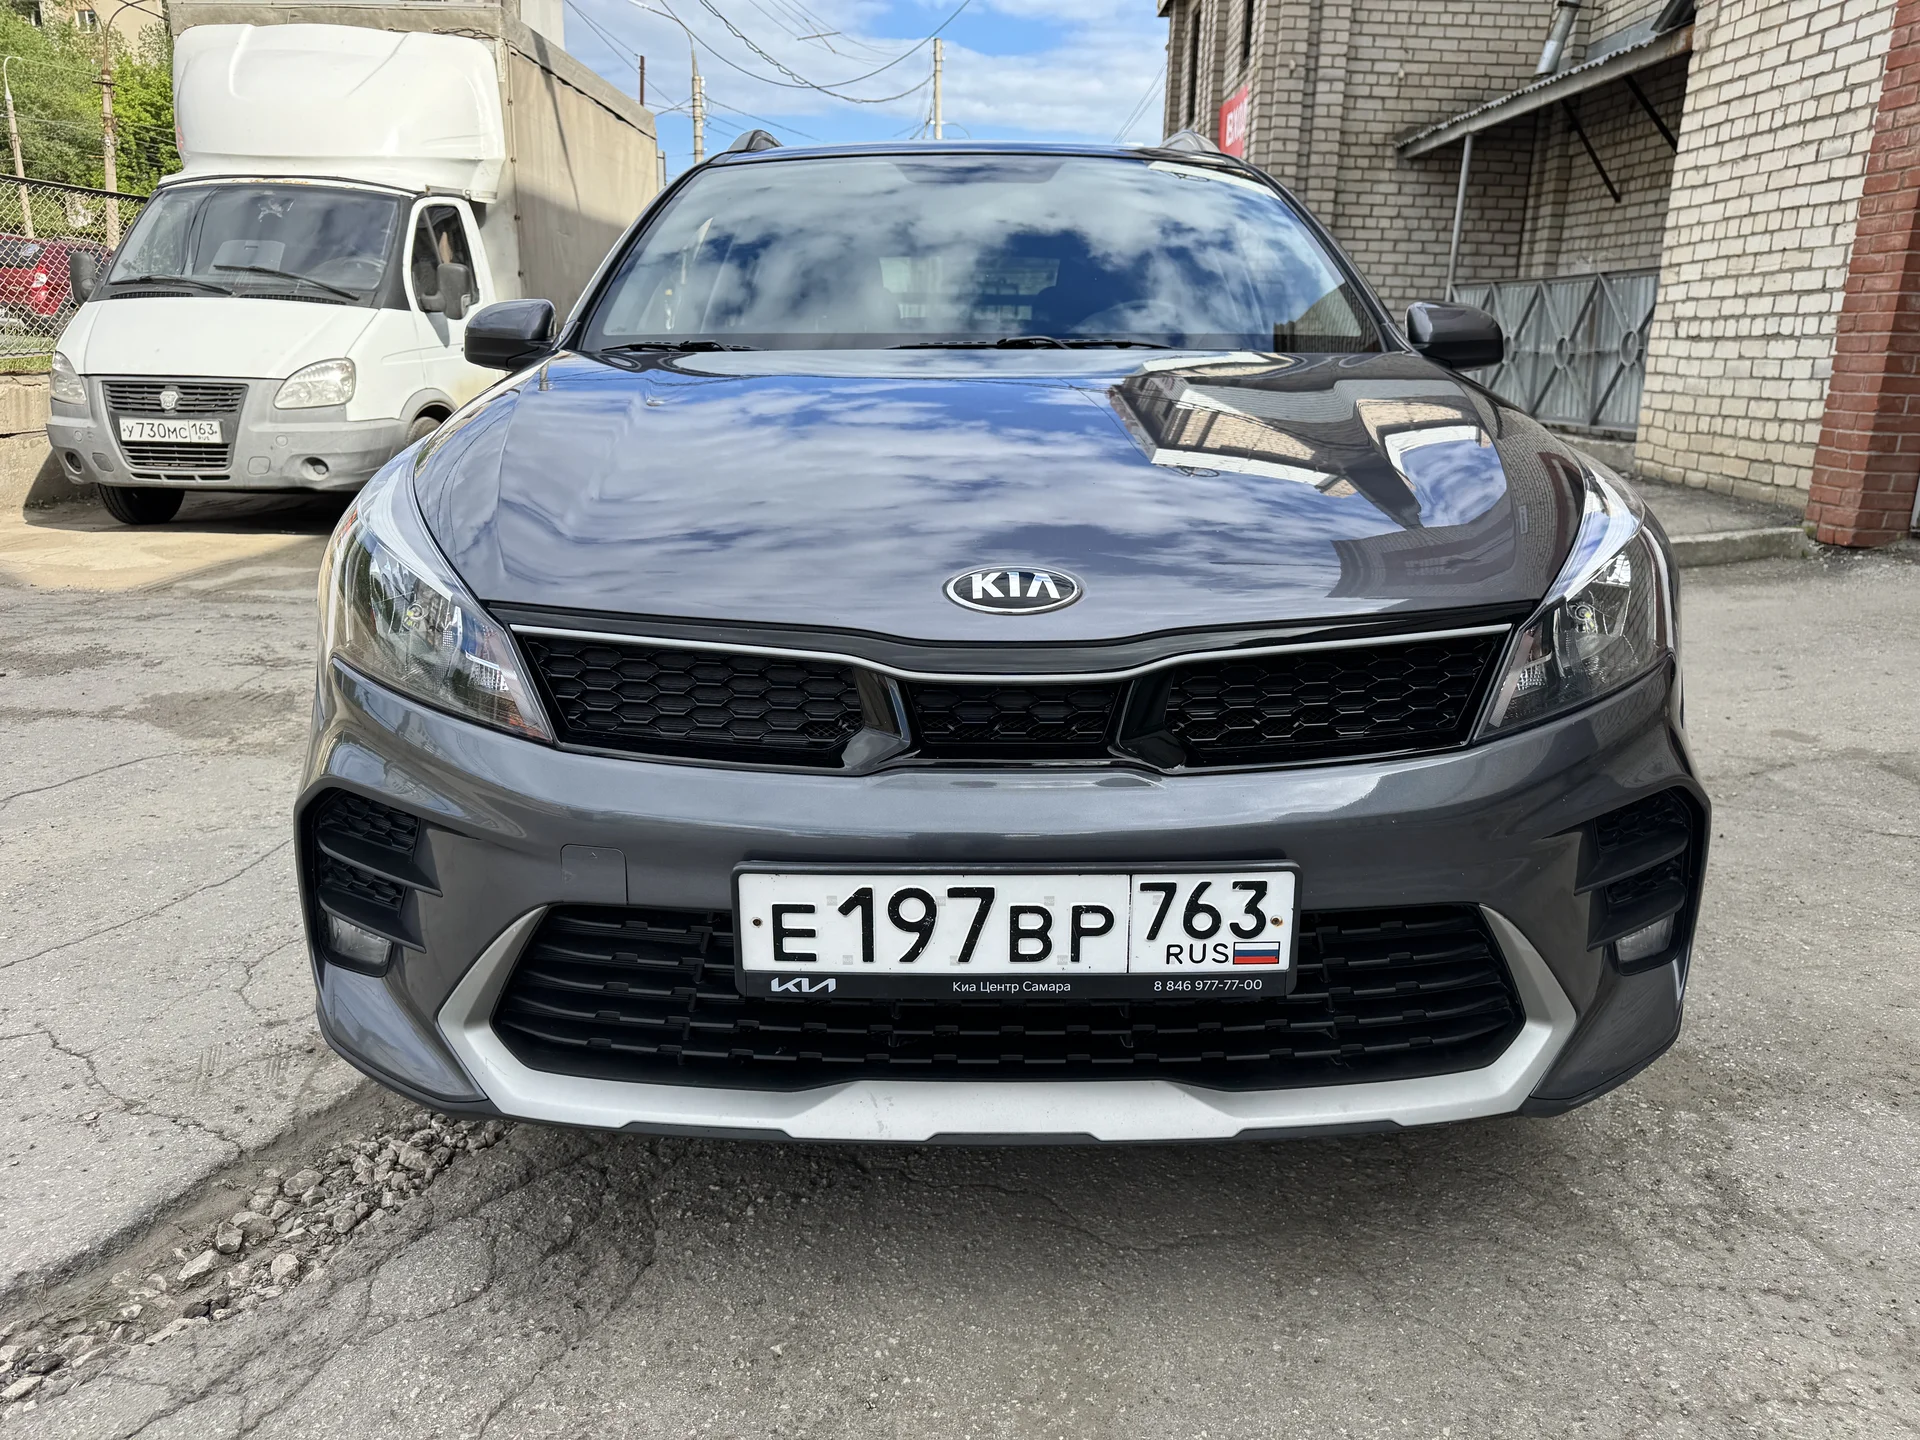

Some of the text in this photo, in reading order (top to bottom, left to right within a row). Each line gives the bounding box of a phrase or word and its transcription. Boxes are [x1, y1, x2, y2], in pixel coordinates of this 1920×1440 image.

[126, 422, 213, 439] У730МС 163
[970, 571, 1061, 600] KIA
[771, 881, 1268, 963] Е197ВР 763
[1165, 943, 1230, 965] RUS
[770, 977, 837, 993] KIA
[952, 980, 1072, 994] Киа Центр Самара
[1153, 979, 1263, 991] 8 846 977-77-00
